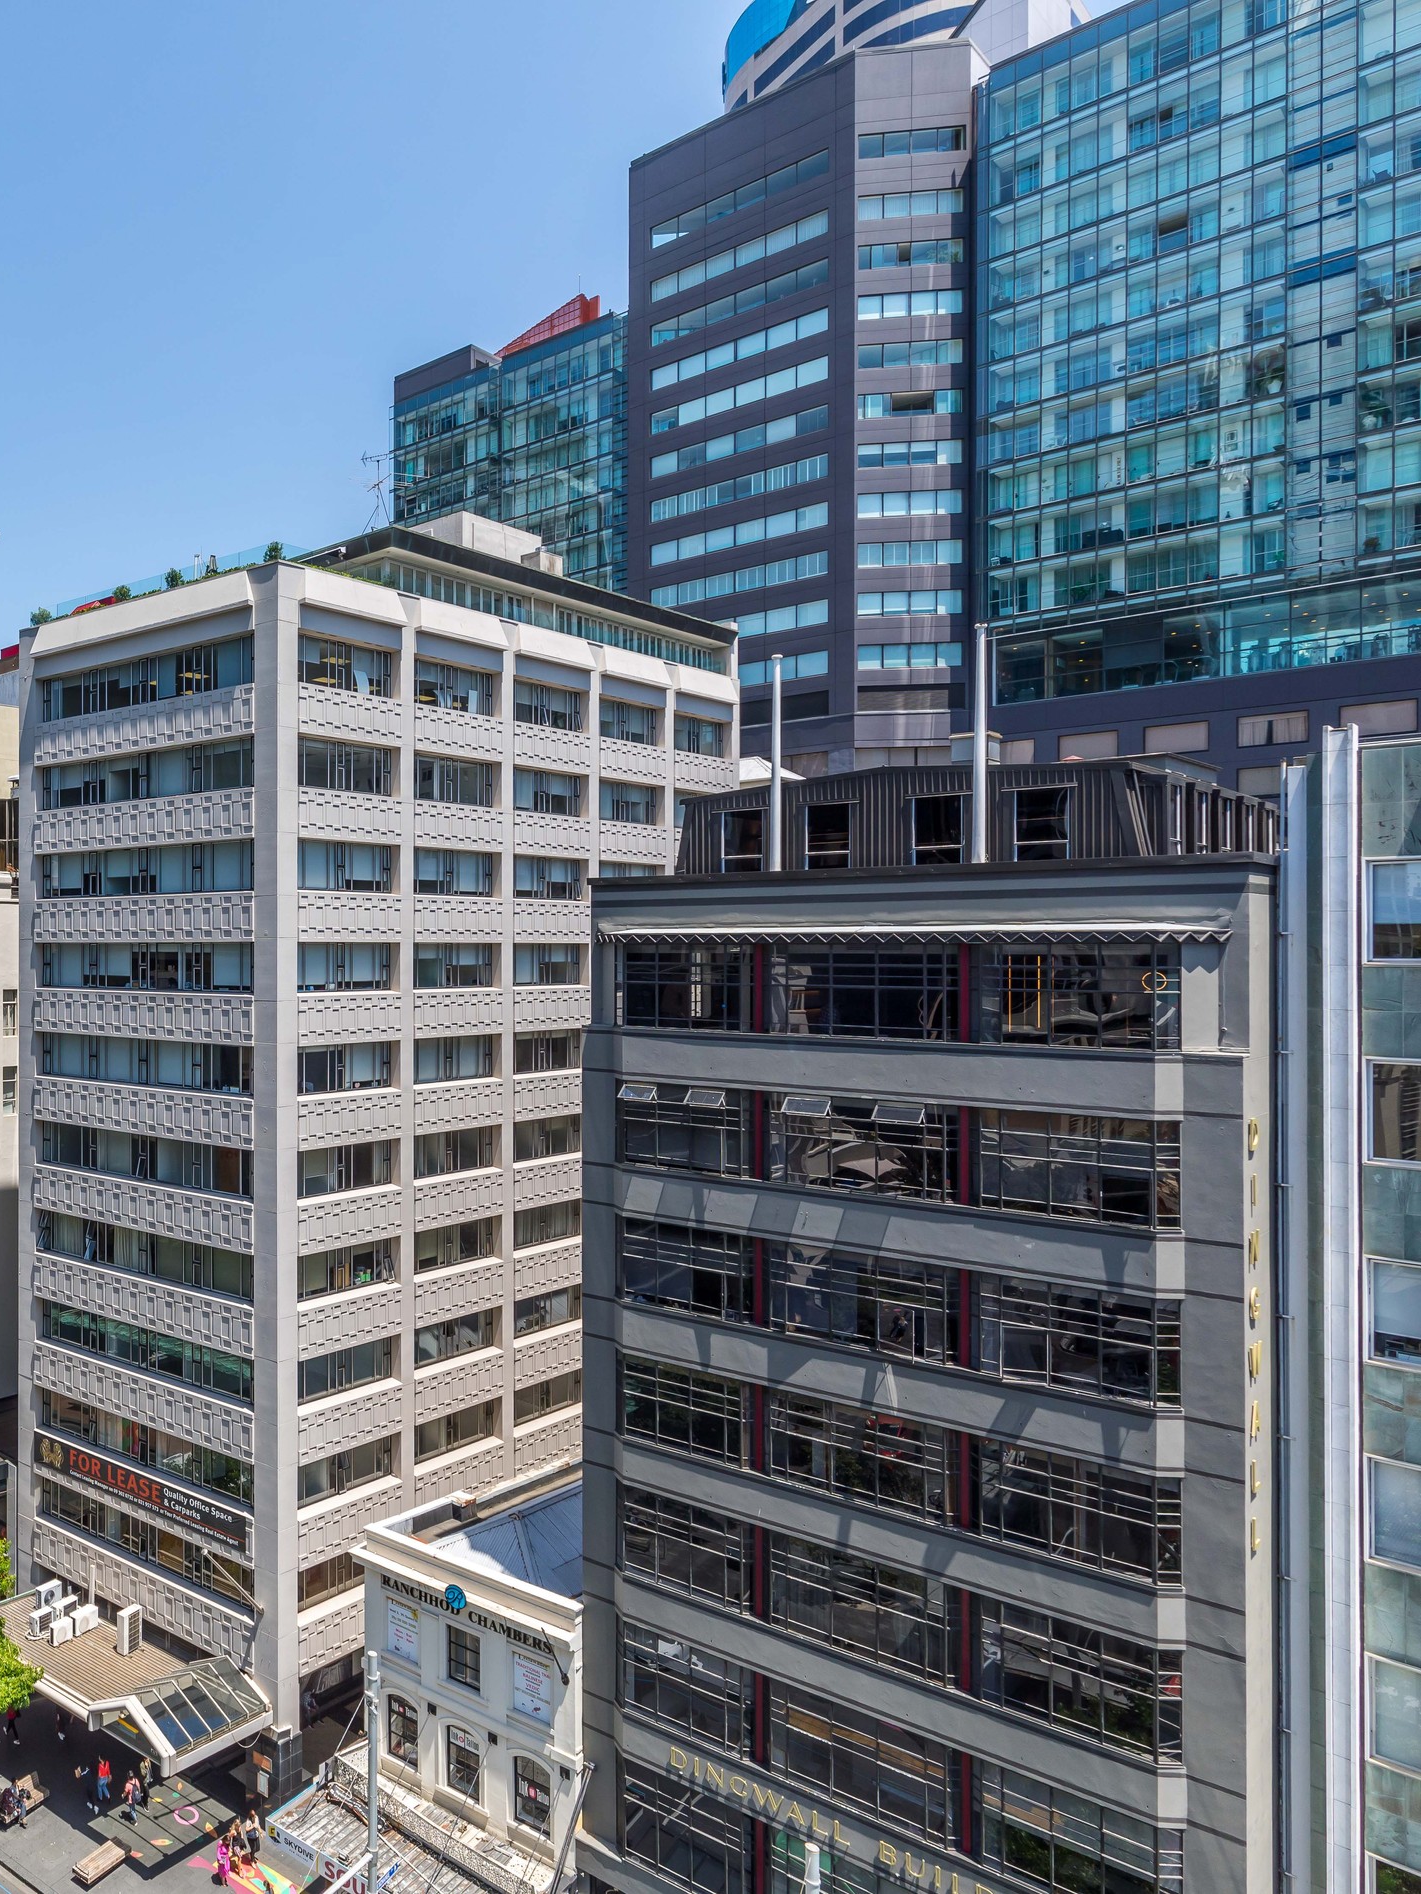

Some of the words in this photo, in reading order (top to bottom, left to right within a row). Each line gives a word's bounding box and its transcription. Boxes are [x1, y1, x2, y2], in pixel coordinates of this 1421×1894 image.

[1247, 1117, 1262, 1552] DINGWALL
[69, 1449, 101, 1477] FOR
[107, 1464, 162, 1502] LEASE
[81, 1474, 95, 1485] Leasing
[94, 1479, 109, 1491] Manager
[190, 1520, 205, 1533] Leasing
[205, 1526, 214, 1535] Real
[214, 1530, 227, 1541] Estate
[226, 1536, 239, 1546] Agent
[163, 1487, 188, 1504] Quality
[189, 1498, 210, 1513] Office
[210, 1507, 233, 1523] Space
[163, 1498, 170, 1507] &
[170, 1501, 200, 1520] Carparks
[468, 1610, 552, 1653] CHAMBERS
[516, 1660, 540, 1675] TRADITIONAL
[522, 1672, 543, 1685] BALINESE
[526, 1682, 540, 1692] VEDIC
[466, 1736, 480, 1752] Tattoo
[518, 1777, 529, 1797] Ink
[536, 1788, 549, 1806] Tattoo
[670, 1746, 851, 1847] DINGWALL
[283, 1837, 315, 1862] SKYDIVE
